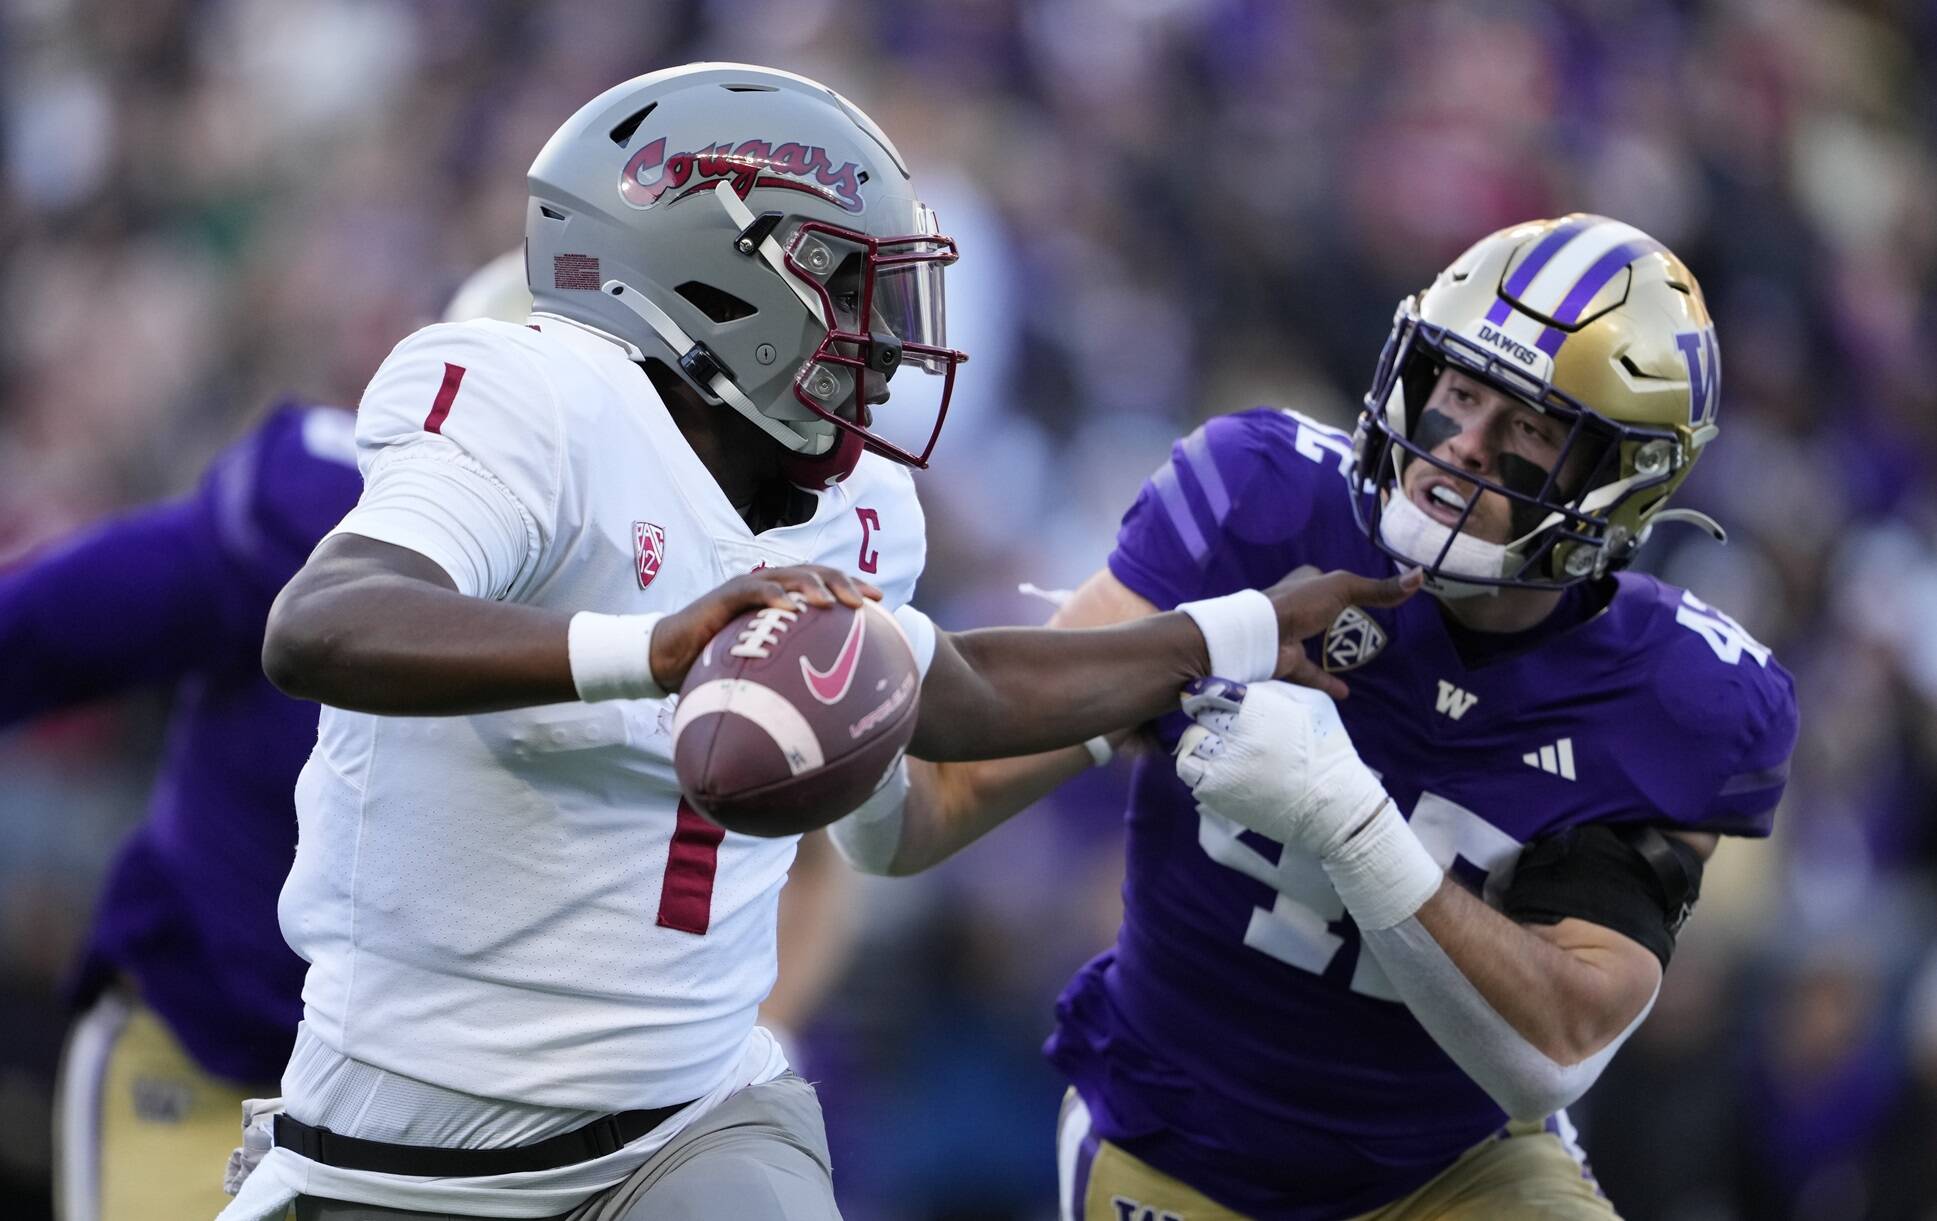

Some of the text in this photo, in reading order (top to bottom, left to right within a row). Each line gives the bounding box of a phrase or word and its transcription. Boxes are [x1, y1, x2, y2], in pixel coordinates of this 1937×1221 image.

[618, 136, 865, 214] Cougars
[1478, 325, 1537, 366] DAWGS
[423, 361, 466, 435] 1
[636, 523, 664, 564] PAC
[855, 506, 881, 574] C
[640, 549, 656, 575] 12
[1327, 634, 1357, 667] 12
[1330, 608, 1382, 661] PAC
[1435, 679, 1478, 720] W
